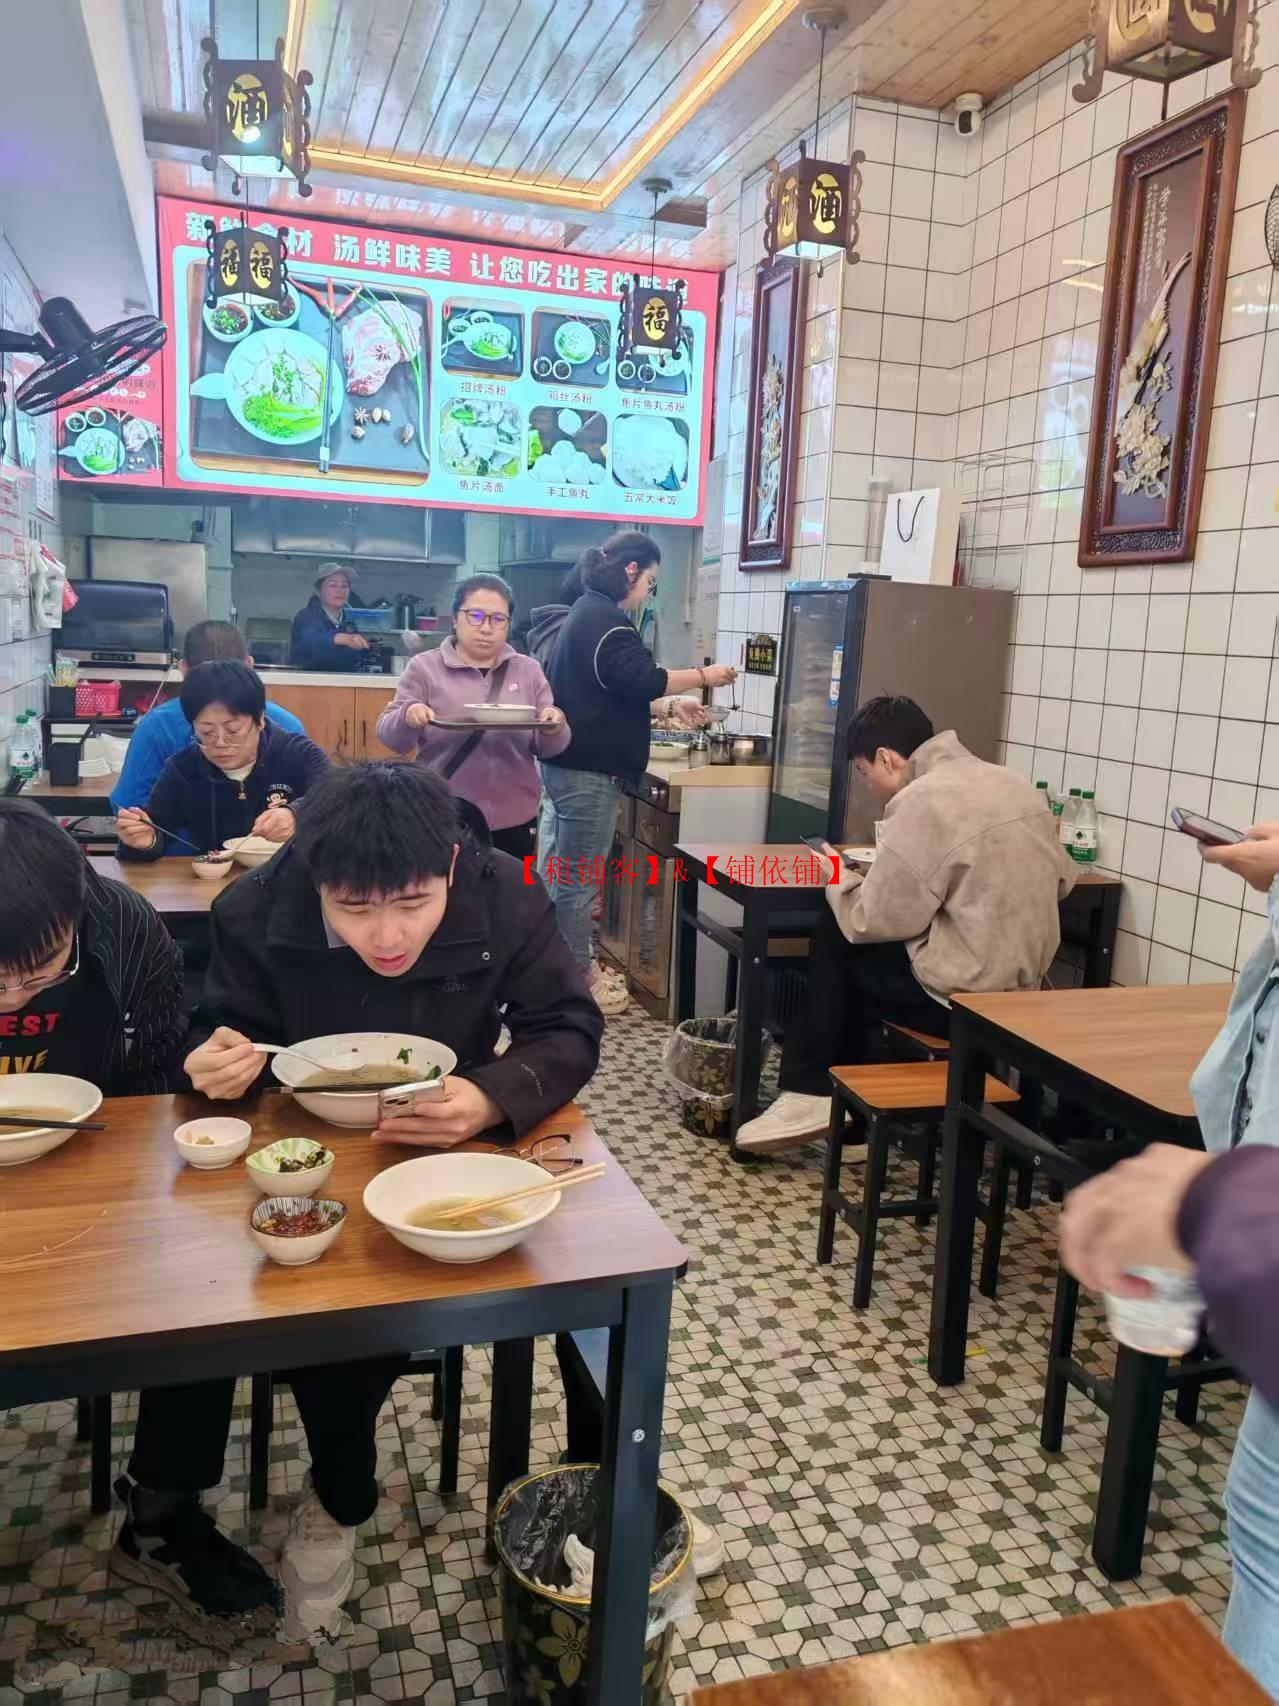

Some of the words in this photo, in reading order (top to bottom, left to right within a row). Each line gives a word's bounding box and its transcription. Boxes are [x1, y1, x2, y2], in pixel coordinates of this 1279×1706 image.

[333, 233, 451, 276] 汤鲜味美
[250, 247, 273, 281] 福
[643, 305, 669, 332] 福
[460, 382, 506, 396] 招牌汤粉
[622, 397, 685, 412] 鱼片鱼丸汤粉
[459, 479, 504, 493] 鱼片汤面
[546, 486, 589, 499] 手工鱼丸
